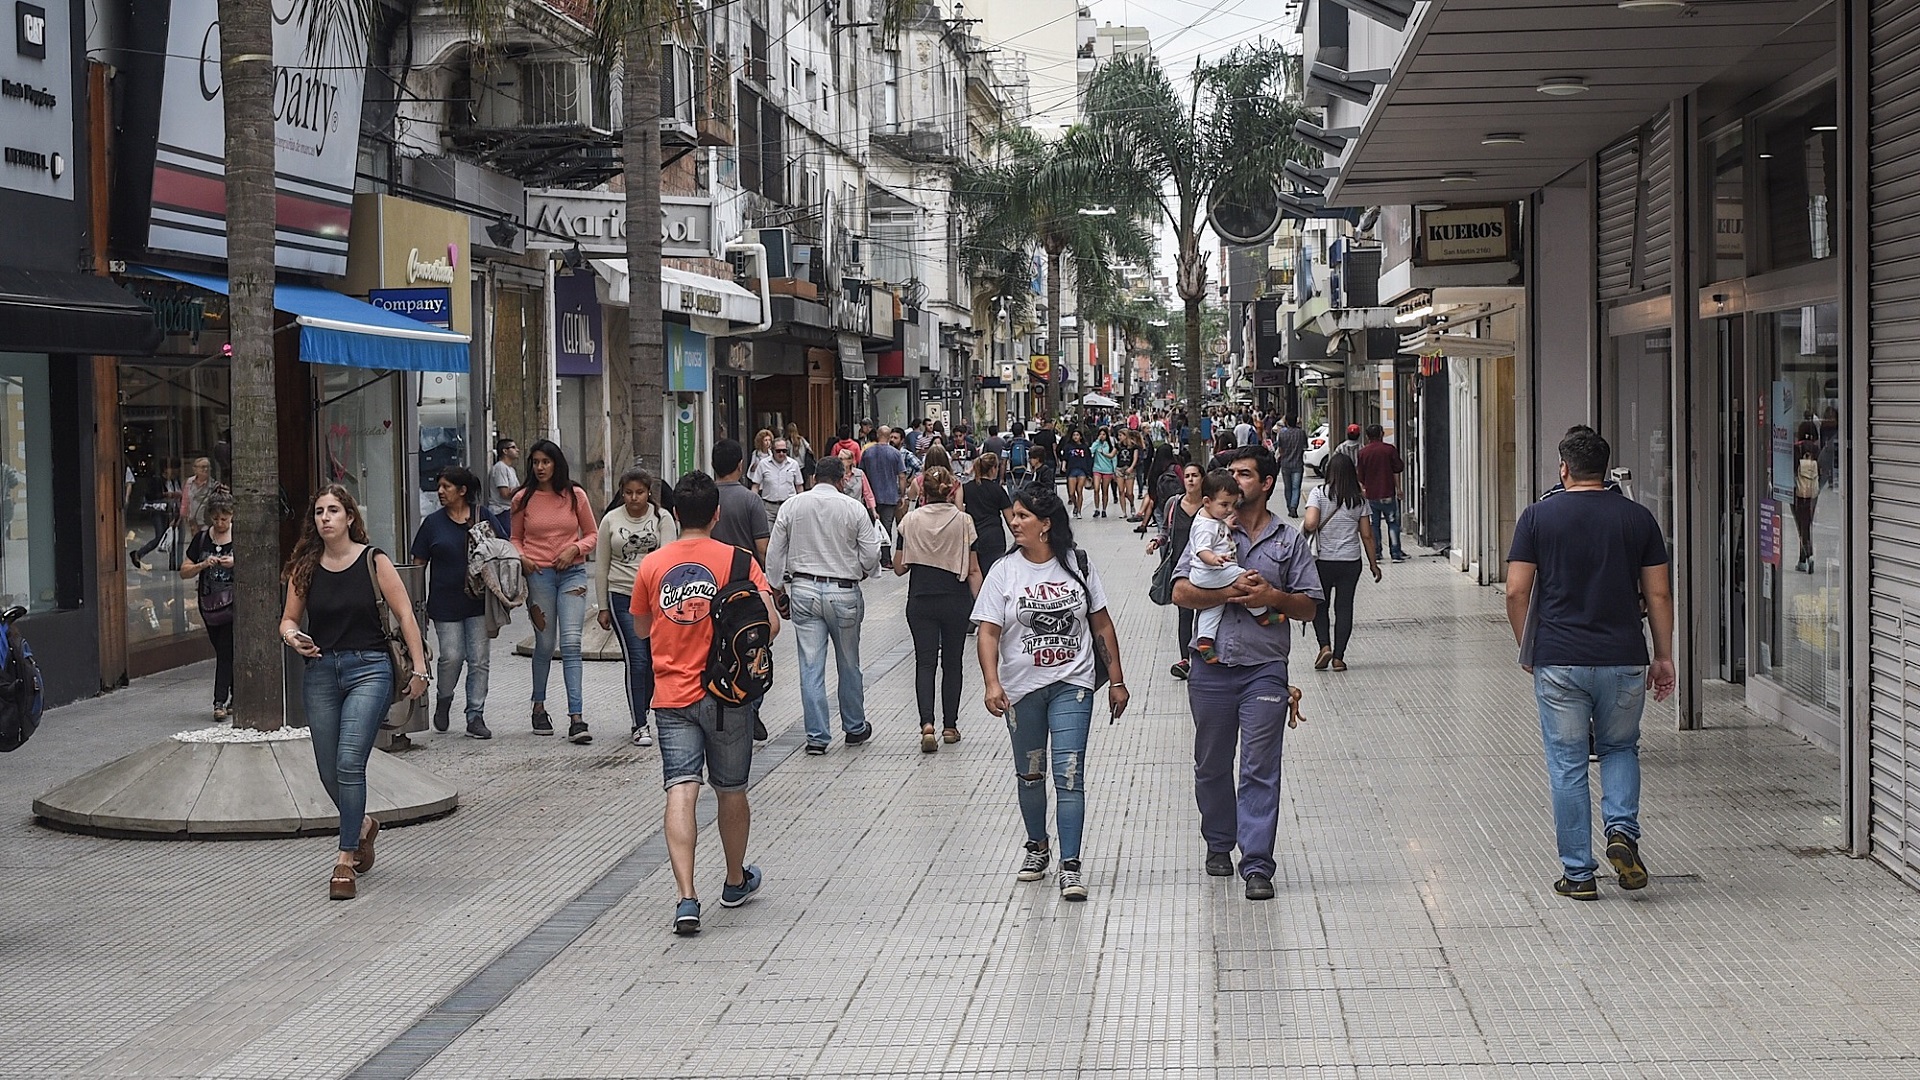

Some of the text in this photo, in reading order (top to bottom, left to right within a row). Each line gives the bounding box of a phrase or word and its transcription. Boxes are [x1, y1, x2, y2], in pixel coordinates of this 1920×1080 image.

[199, 21, 337, 157] Cpany
[1429, 222, 1502, 241] KUERO'S
[664, 582, 717, 607] California
[1024, 581, 1070, 600] VANS
[1044, 636, 1060, 645] THE
[1033, 648, 1076, 667] 1966
